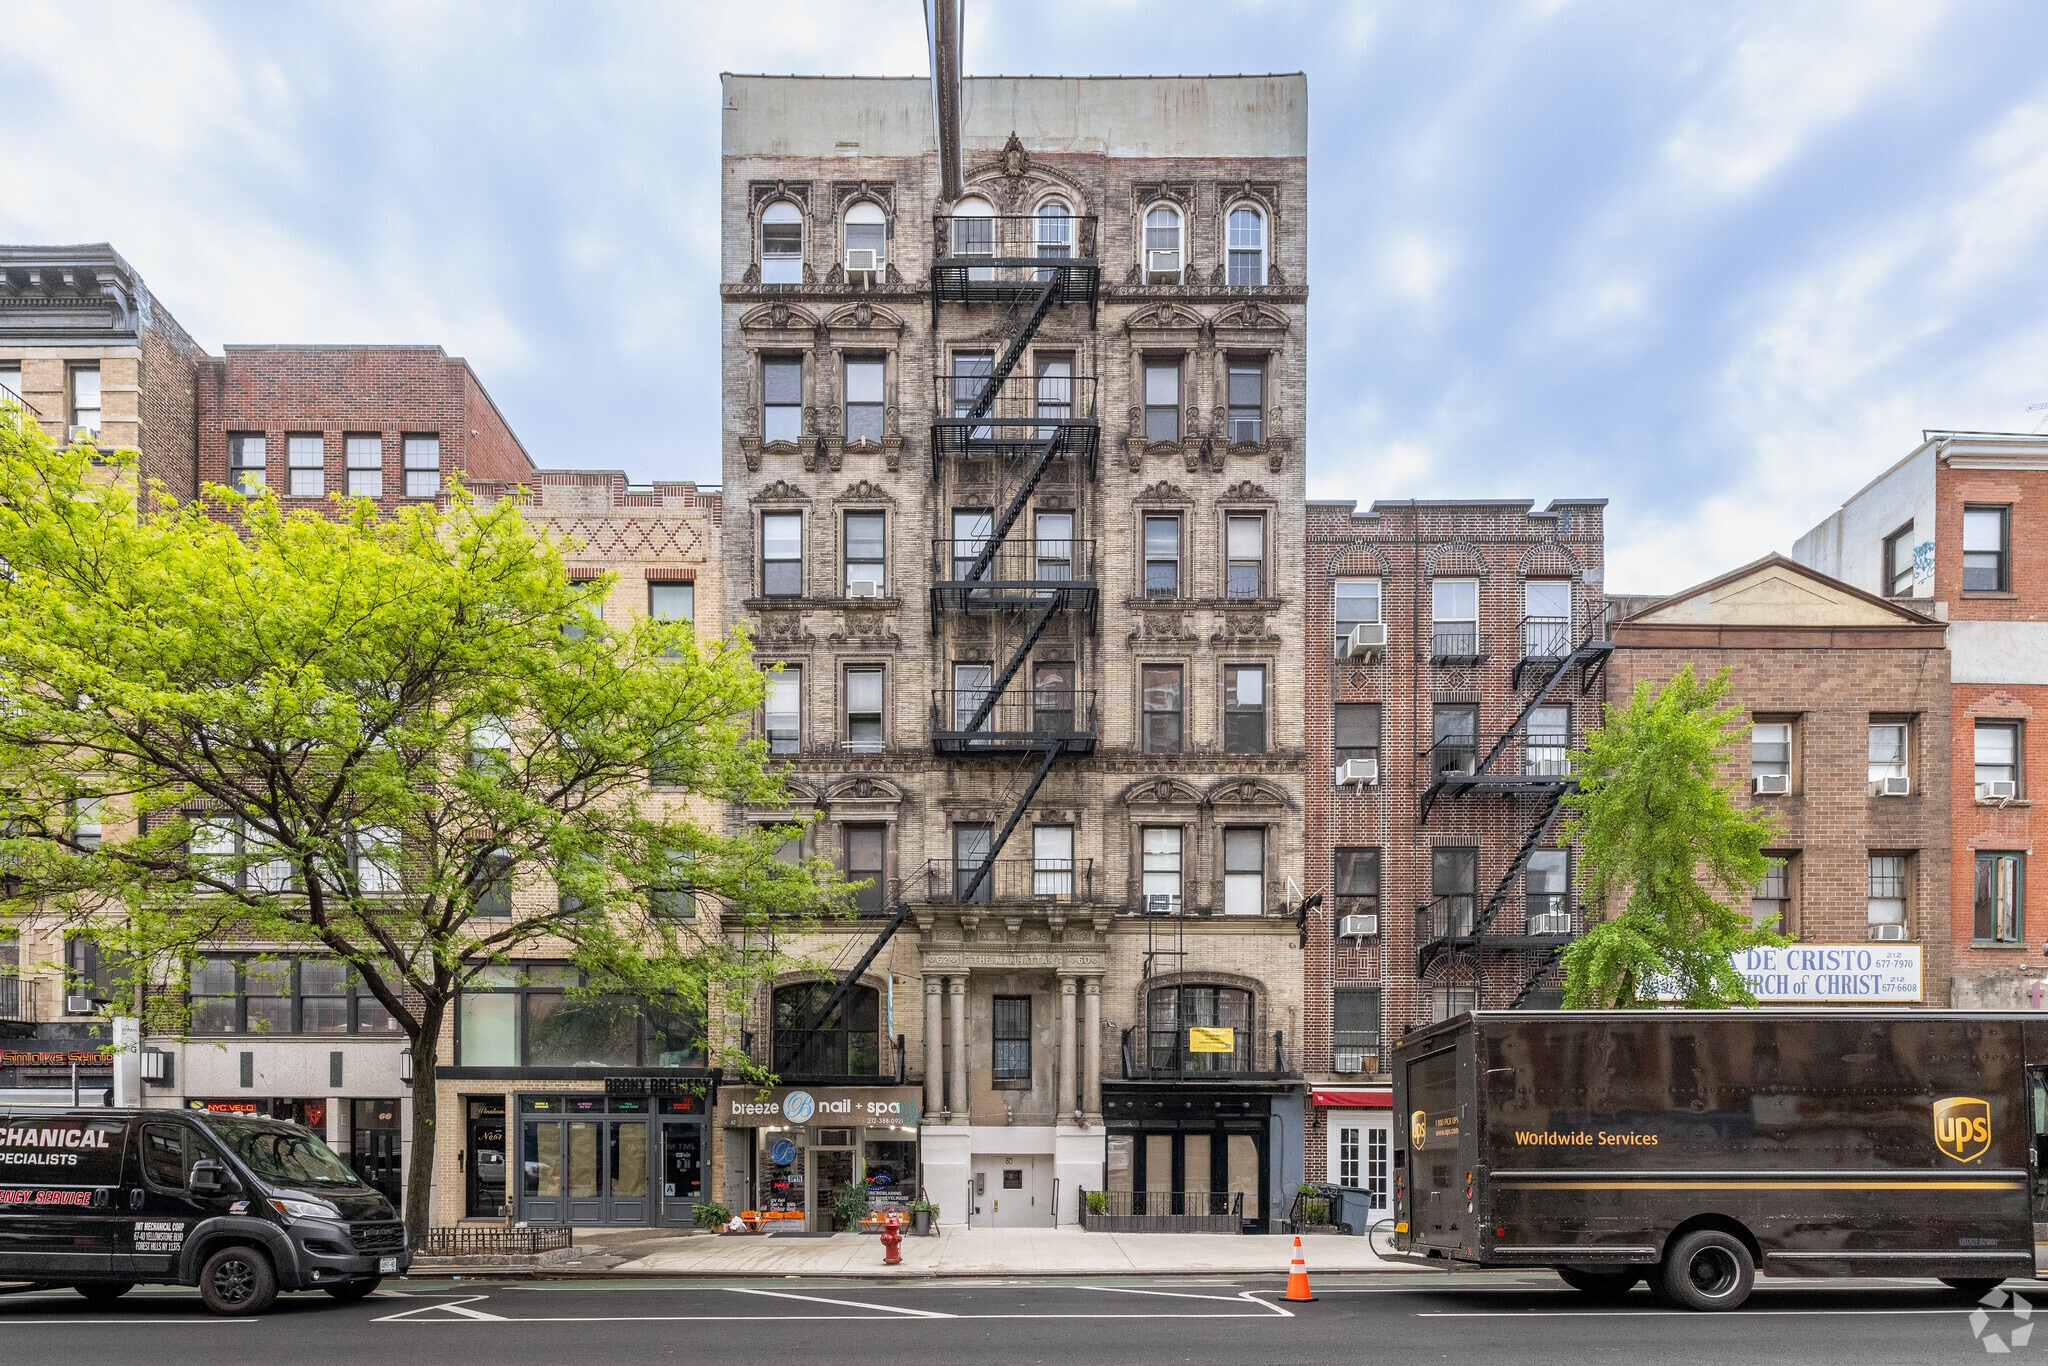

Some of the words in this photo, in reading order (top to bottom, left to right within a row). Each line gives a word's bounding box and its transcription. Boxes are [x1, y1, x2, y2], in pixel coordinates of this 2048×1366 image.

[972, 955, 991, 964] THE
[995, 955, 1053, 966] MANHATTAN
[1077, 956, 1091, 965] 60
[1746, 950, 1777, 970] DE
[1786, 950, 1872, 971] CRISTO
[1876, 960, 1913, 968] 677-7970
[1793, 975, 1810, 995] of
[1815, 974, 1883, 995] CHRIST
[1882, 983, 1917, 993] 677-6608
[605, 1078, 647, 1094] BRONX
[650, 1078, 710, 1095] BREWERY
[732, 1101, 779, 1115] breeze
[819, 1099, 851, 1113] nail
[867, 1102, 900, 1116] spa
[379, 1112, 393, 1120] 66
[1413, 1121, 1426, 1144] ups
[1515, 1131, 1594, 1146] Worldwide
[1598, 1131, 1659, 1146] Services
[1938, 1116, 1988, 1153] ups
[35, 1191, 92, 1205] SERVICE
[144, 1222, 171, 1231] MECHANICAL
[135, 1242, 150, 1250] FOREST
